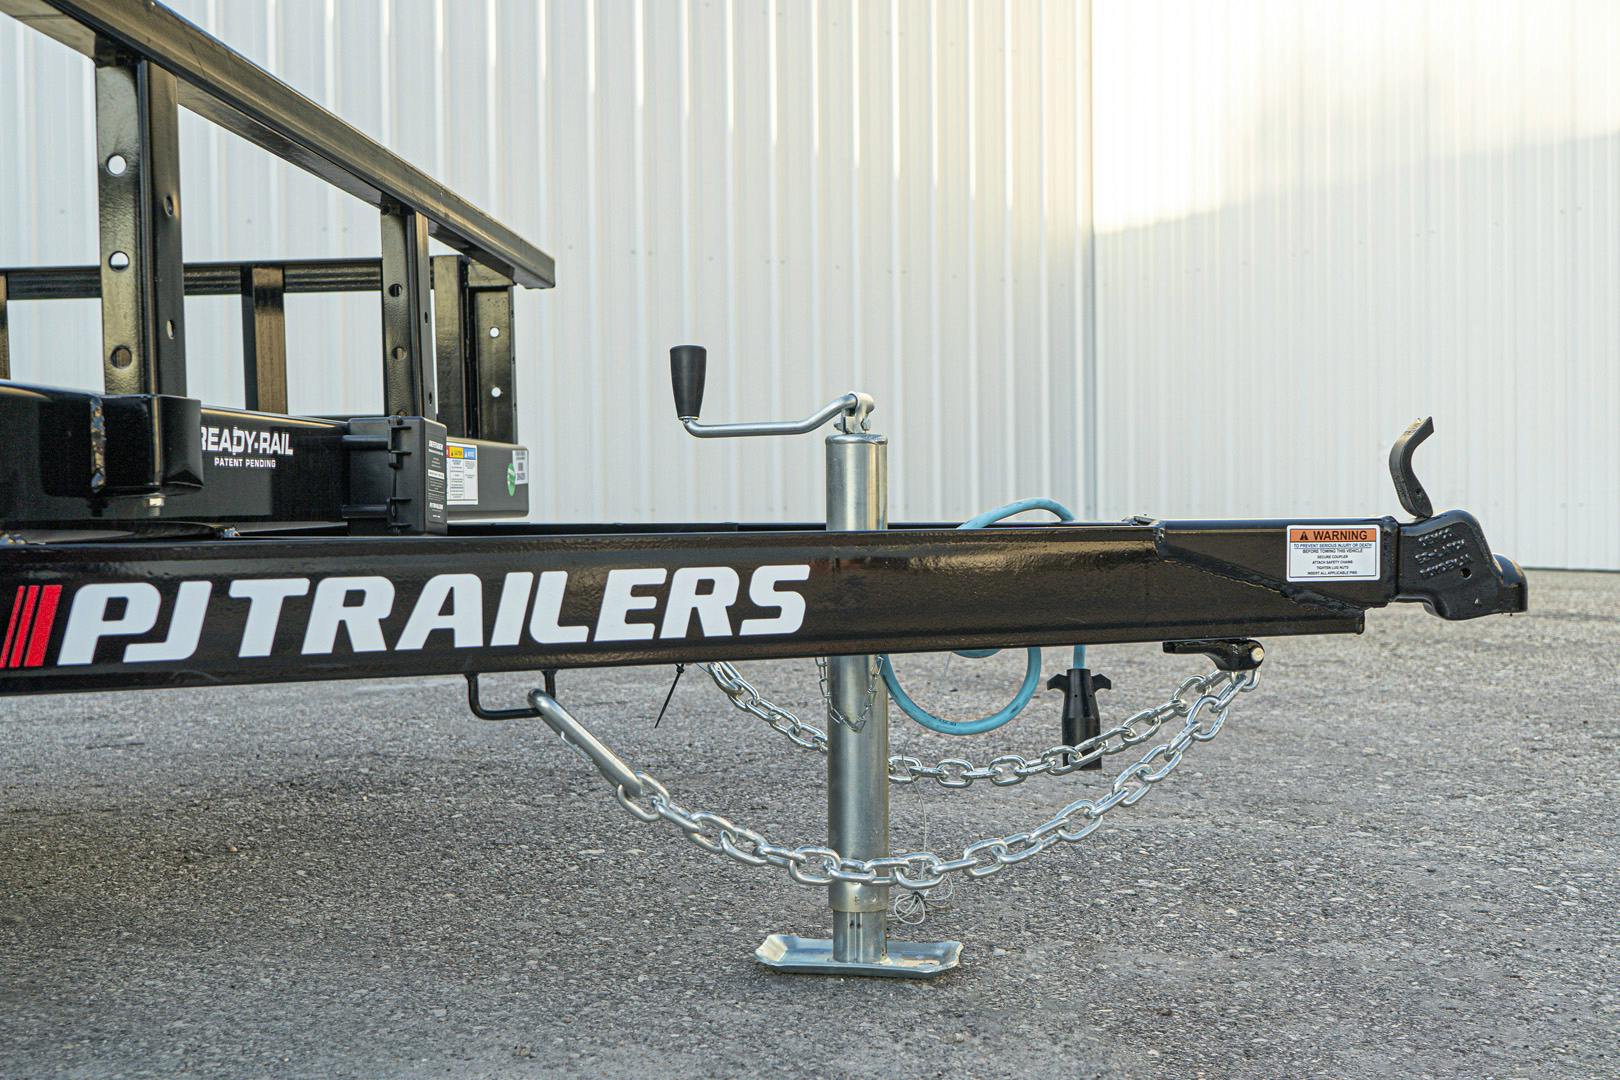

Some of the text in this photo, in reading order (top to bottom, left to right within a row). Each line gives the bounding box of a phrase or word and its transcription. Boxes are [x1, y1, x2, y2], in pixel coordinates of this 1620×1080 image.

[214, 457, 276, 468] PATENT PENDING
[1313, 530, 1367, 540] WARNING
[56, 564, 812, 666] PJ TRAILERS
